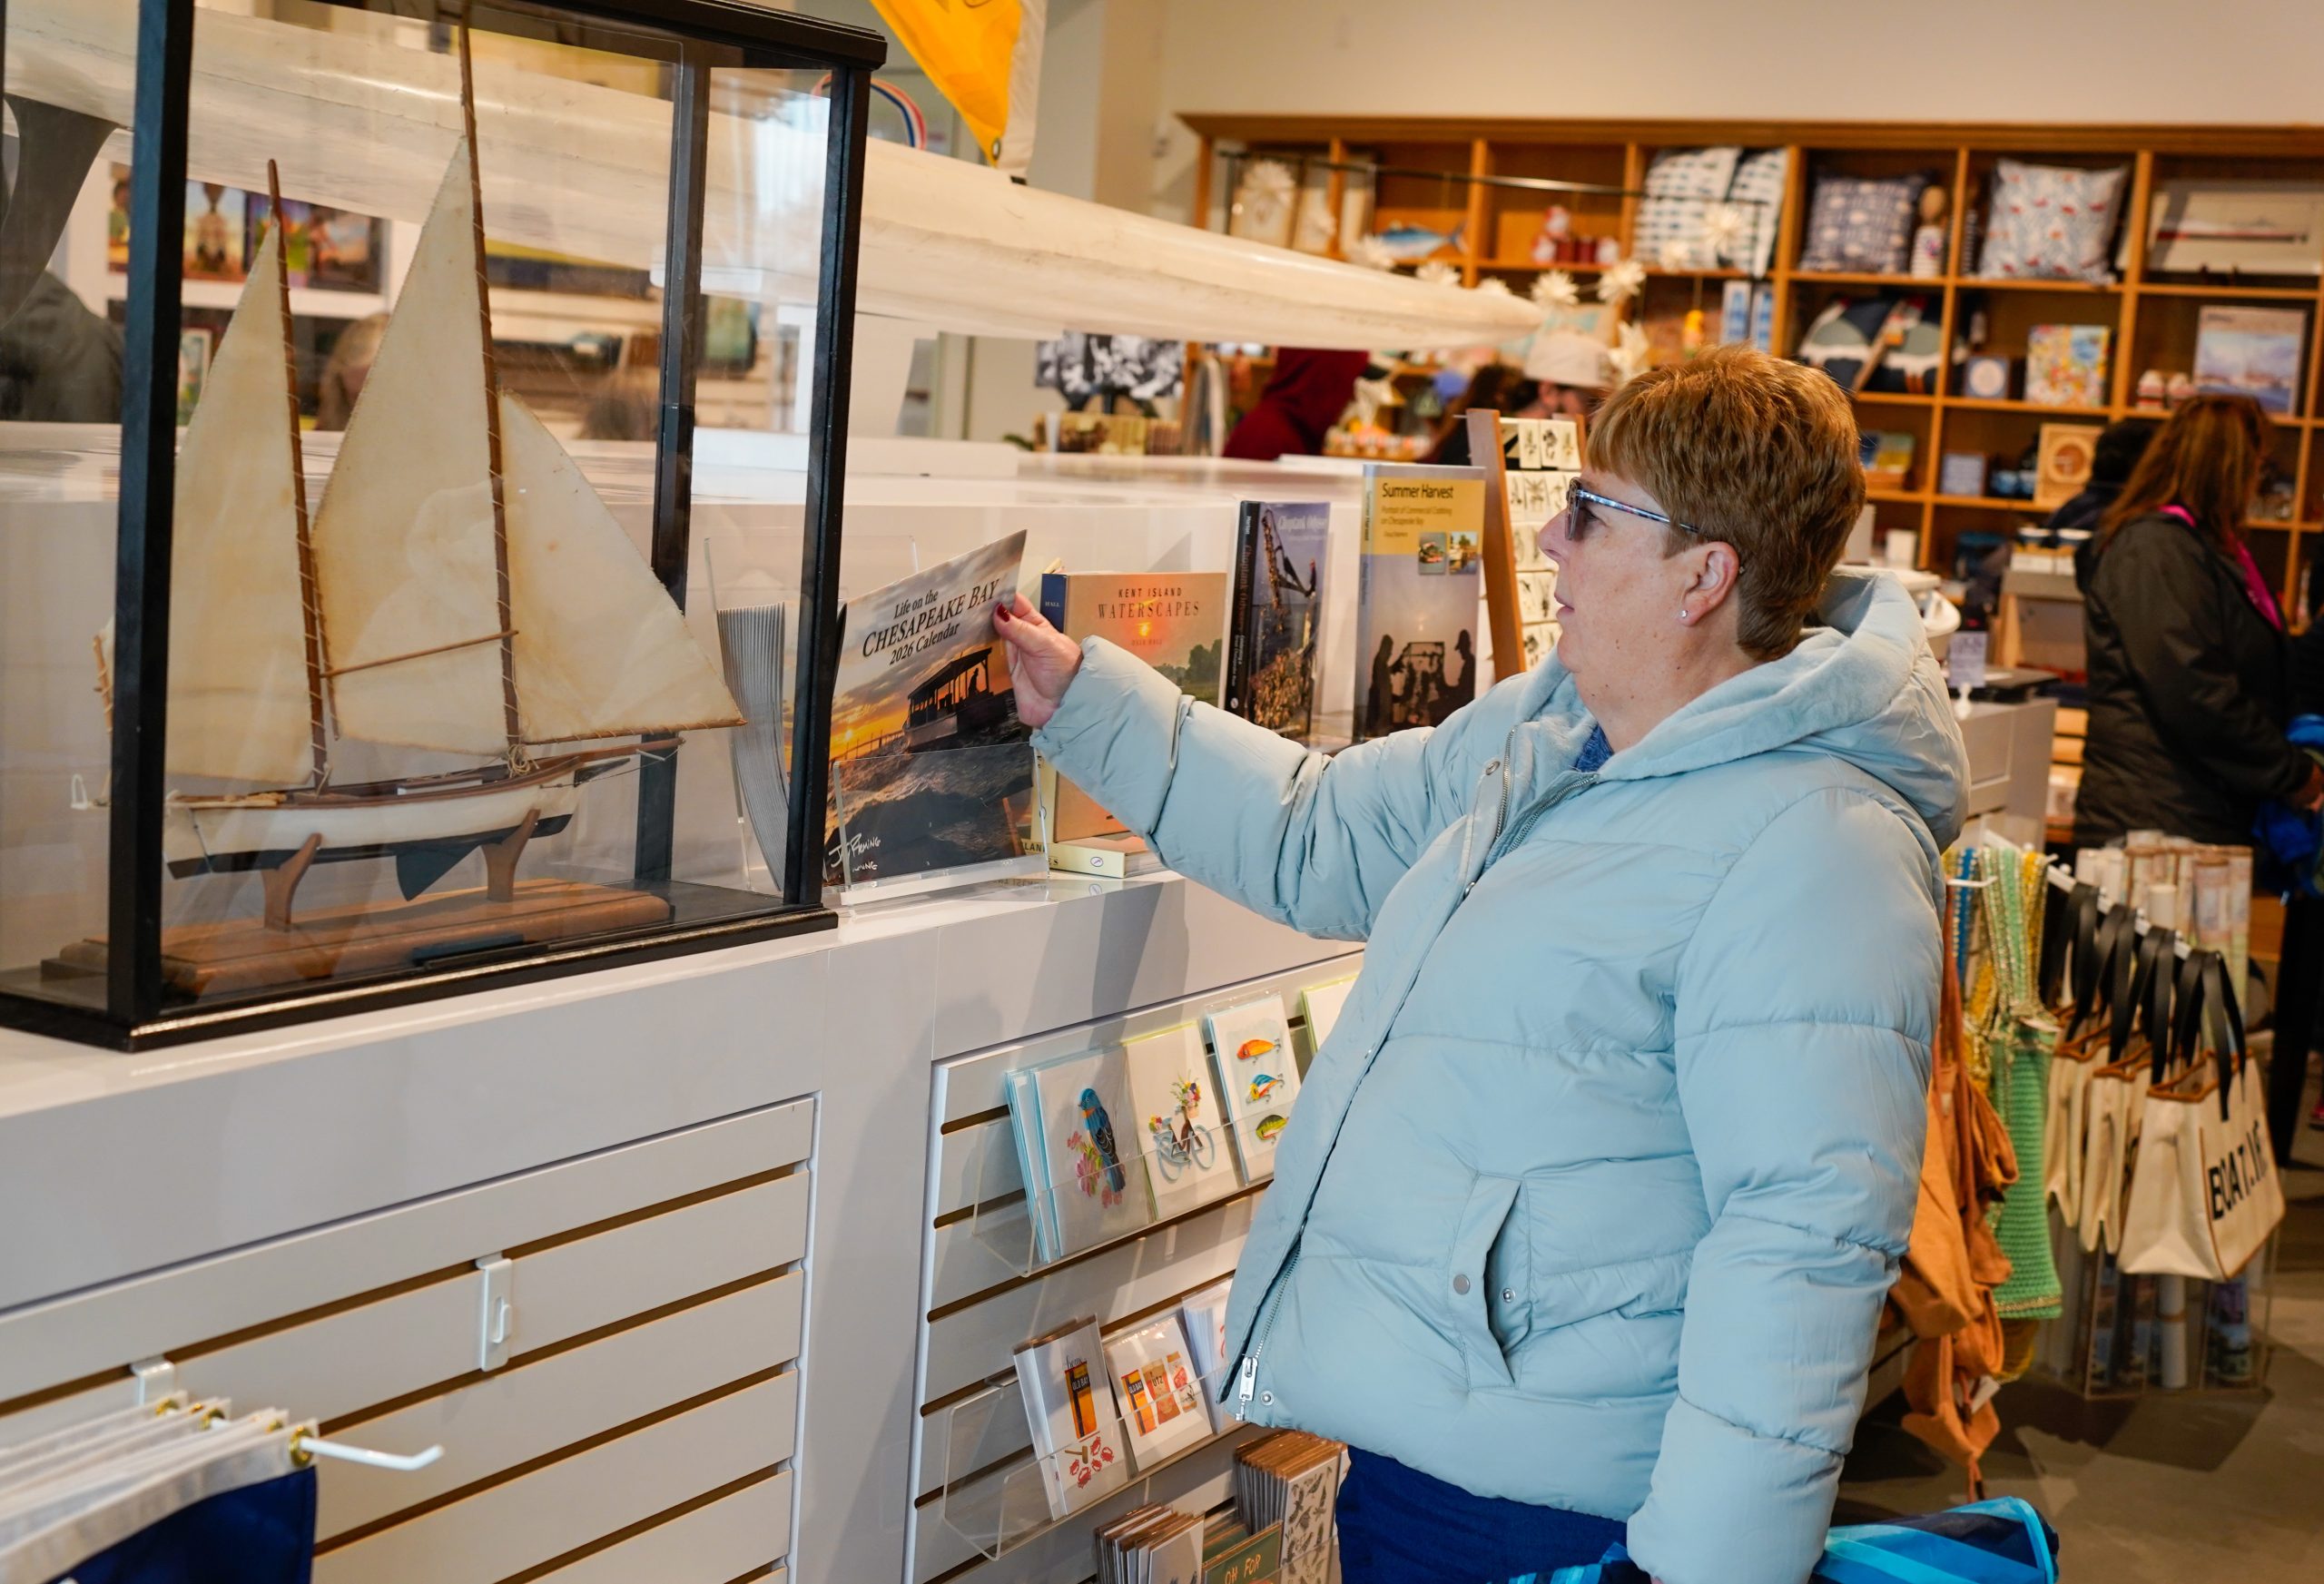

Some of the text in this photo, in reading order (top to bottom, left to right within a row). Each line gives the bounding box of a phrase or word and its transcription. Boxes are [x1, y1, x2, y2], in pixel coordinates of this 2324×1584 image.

[1383, 483, 1453, 498] Summer Harvest
[893, 589, 939, 620] Life on the
[1118, 587, 1183, 598] KENT ISLAND
[862, 578, 1000, 657] CHESAPEAKE BAY
[1098, 601, 1199, 619] WATERSCAPES
[889, 623, 961, 665] 2026 Calendar
[1244, 1554, 1261, 1578] FOR
